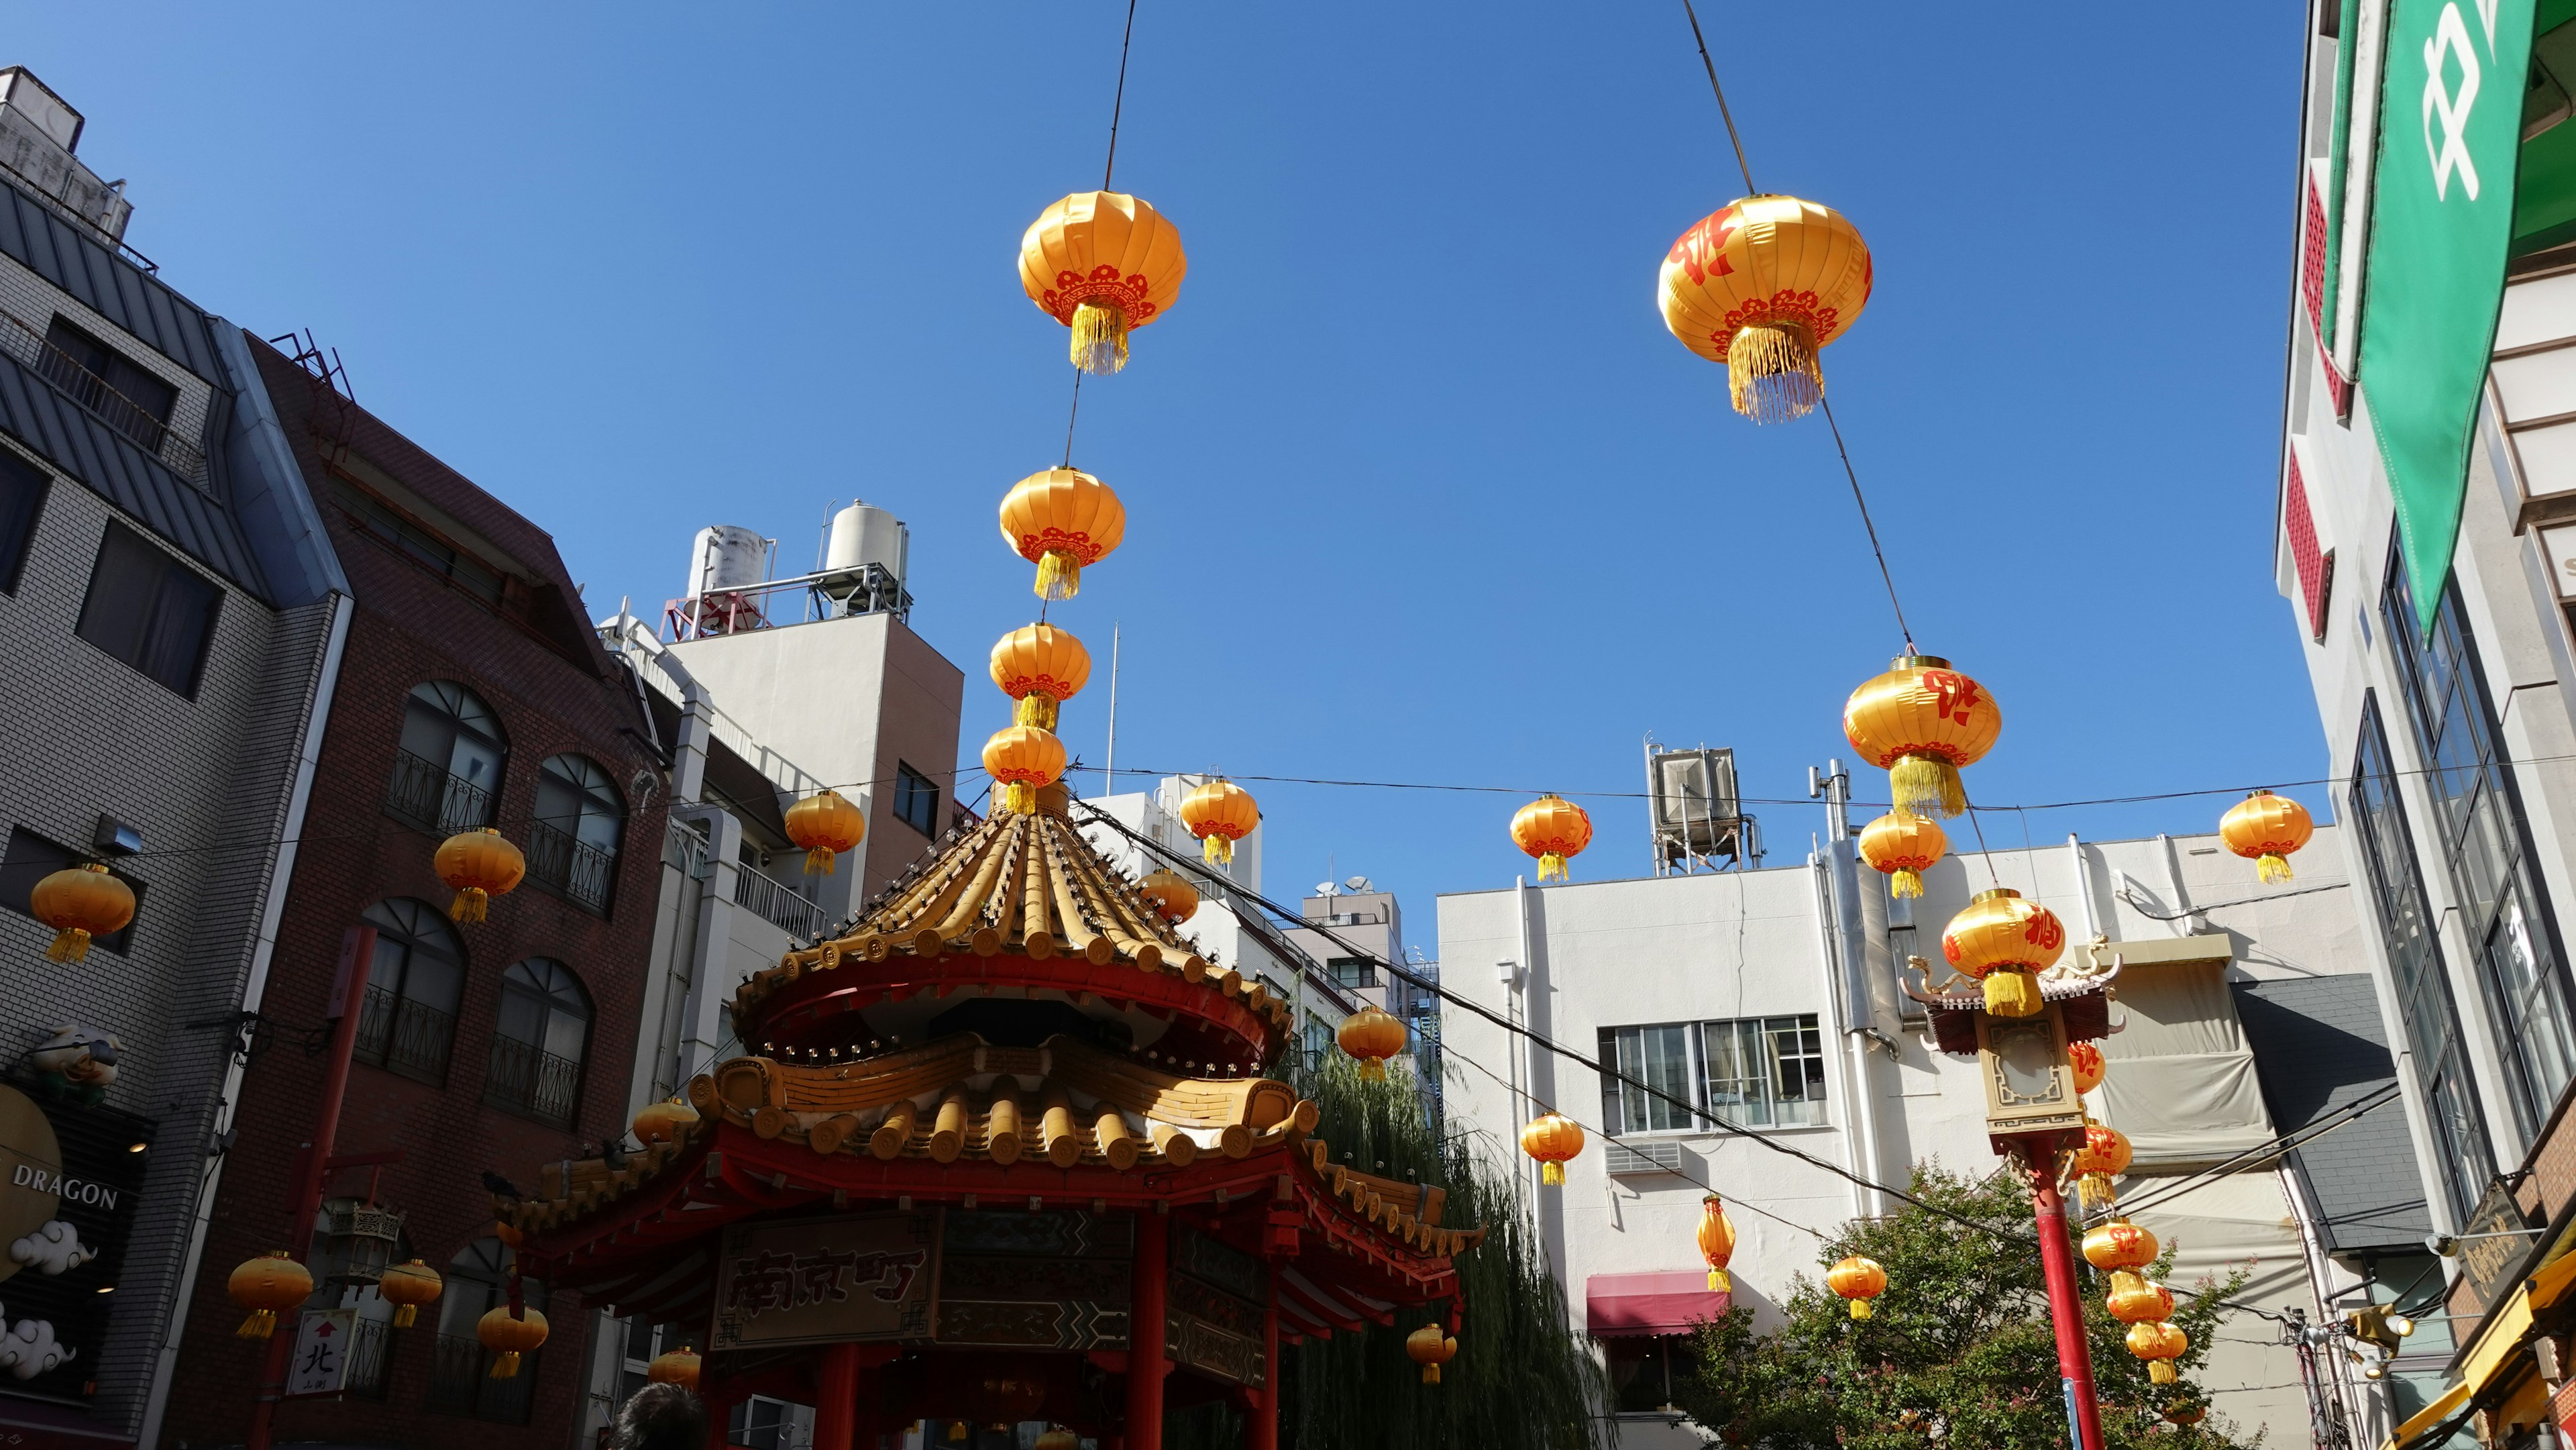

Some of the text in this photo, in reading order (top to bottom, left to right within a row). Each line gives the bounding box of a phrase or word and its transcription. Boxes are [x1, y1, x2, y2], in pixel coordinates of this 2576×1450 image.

[2025, 904, 2061, 949] 福
[13, 1164, 118, 1210] DRAGON
[728, 1247, 926, 1317] 南京町
[302, 1343, 333, 1374] 北
